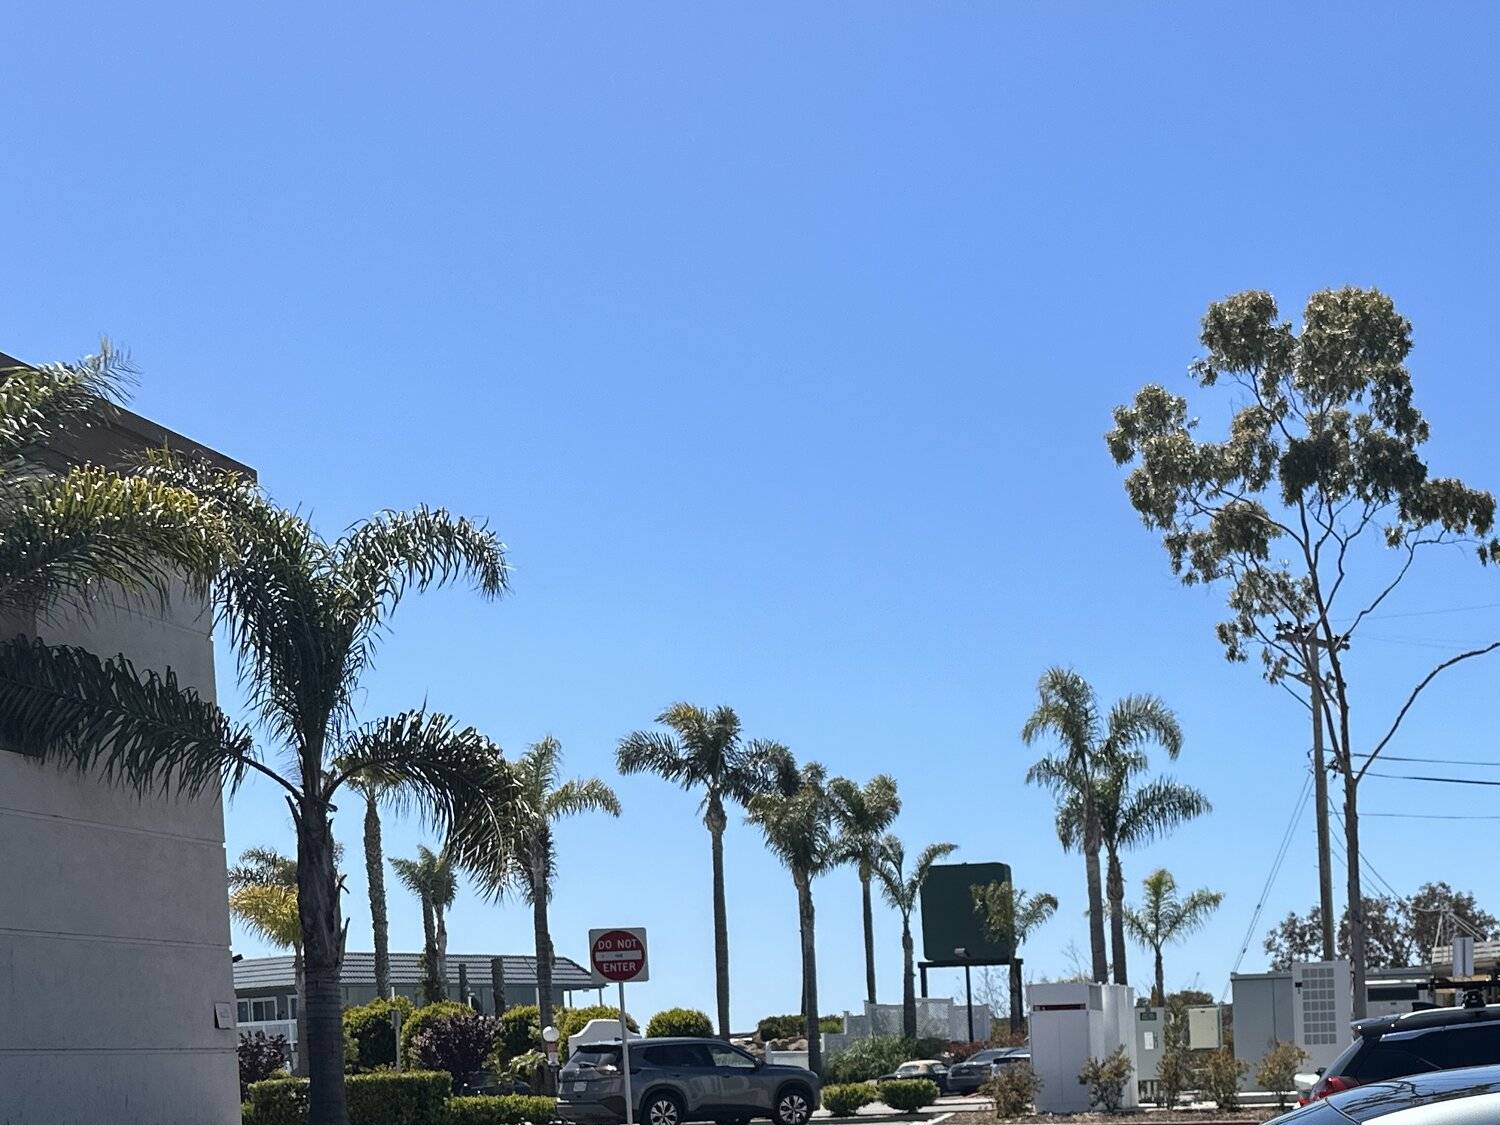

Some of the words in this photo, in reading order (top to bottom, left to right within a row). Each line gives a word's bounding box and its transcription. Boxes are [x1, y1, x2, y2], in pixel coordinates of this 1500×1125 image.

[598, 940, 612, 950] DO
[617, 939, 637, 949] NOT
[603, 962, 636, 973] ENTER
